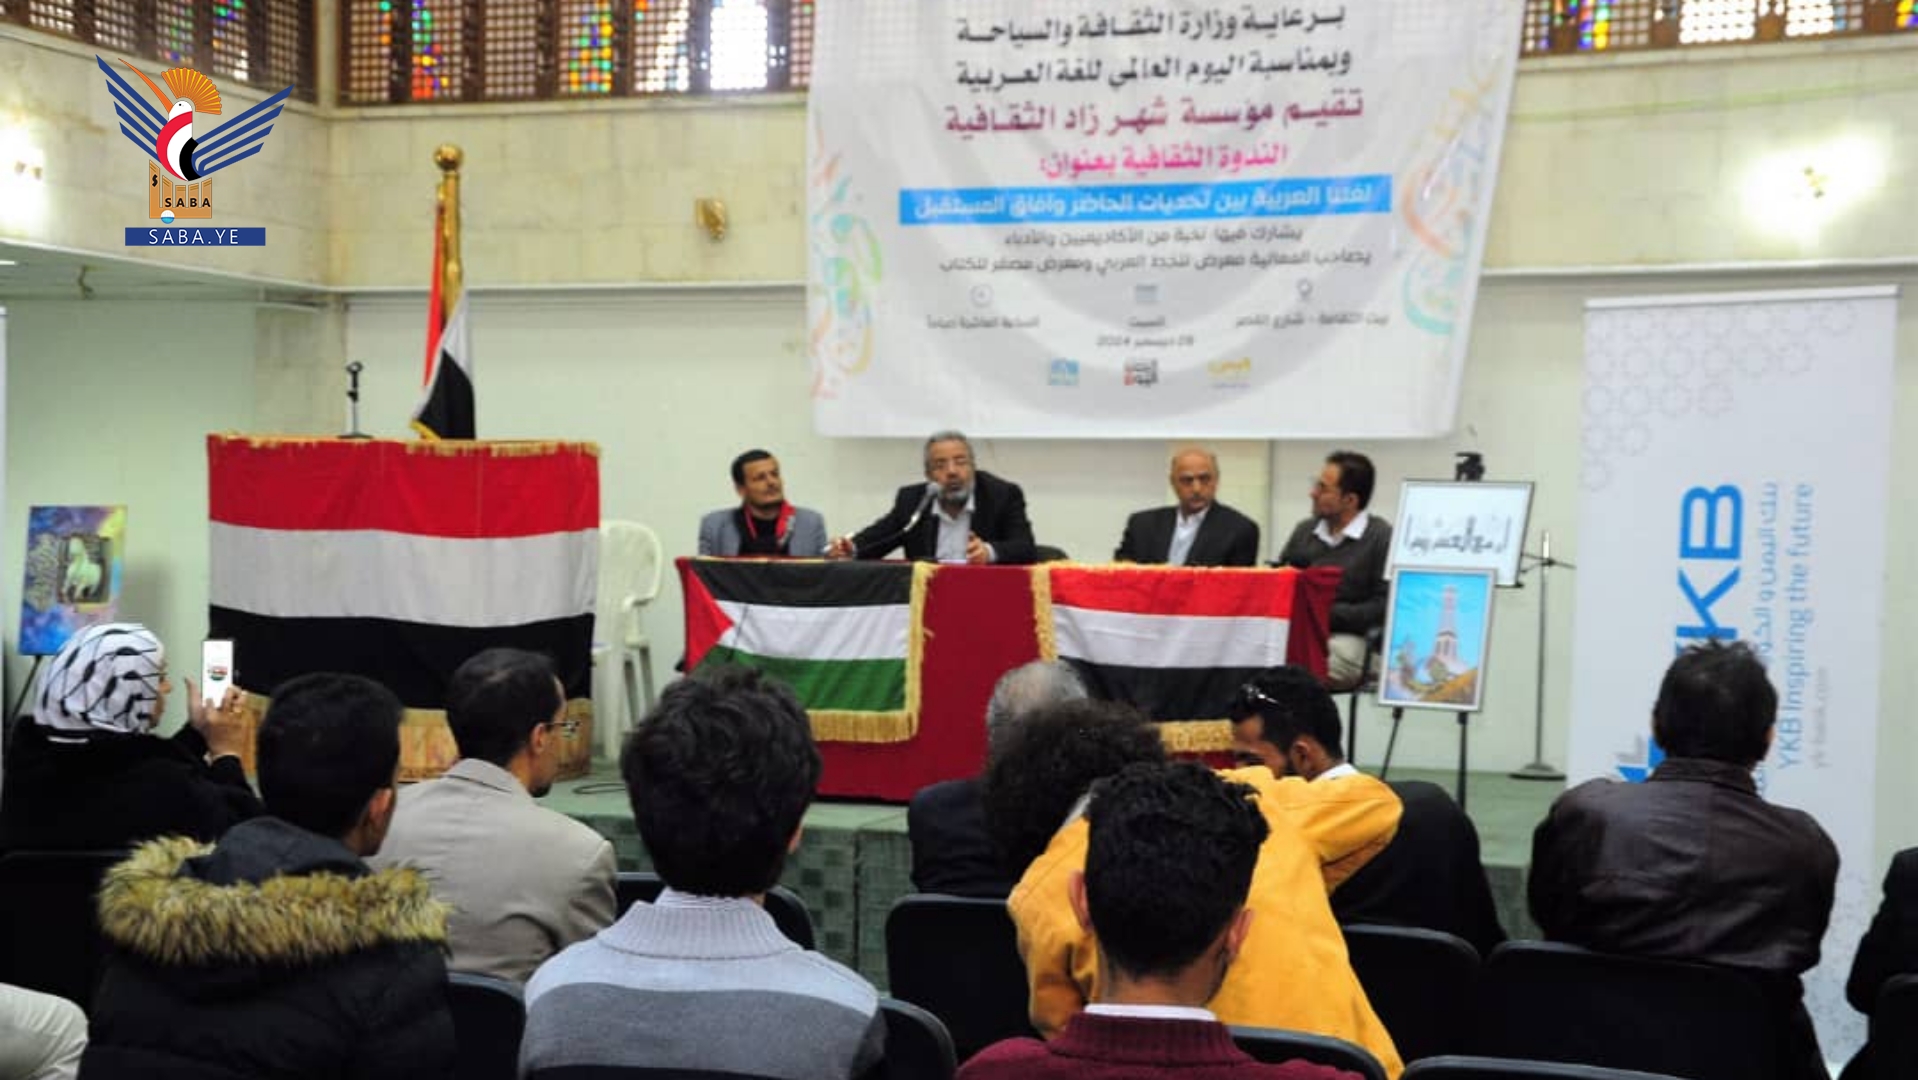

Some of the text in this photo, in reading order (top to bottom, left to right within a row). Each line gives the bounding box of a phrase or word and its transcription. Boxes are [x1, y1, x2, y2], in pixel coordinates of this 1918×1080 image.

[957, 6, 1345, 47] برعاية وزارة الثقافة والسياحة
[957, 47, 1352, 92] وبمناسبة اليوم العالمي للغة العربية
[945, 101, 1055, 140] الثقافية
[1065, 104, 1099, 136] زاد
[1282, 88, 1364, 128] تقيم
[1123, 143, 1213, 177] الثقافية
[1219, 141, 1288, 173] الندوة
[914, 194, 1005, 219] المستقبل
[1069, 192, 1133, 215] الحاضر
[1138, 189, 1212, 214] تحديات
[1214, 190, 1249, 213] بين
[1252, 186, 1321, 210] العربية
[1676, 485, 1742, 655] KB
[1777, 484, 1815, 770] YKB Inspiring the future
